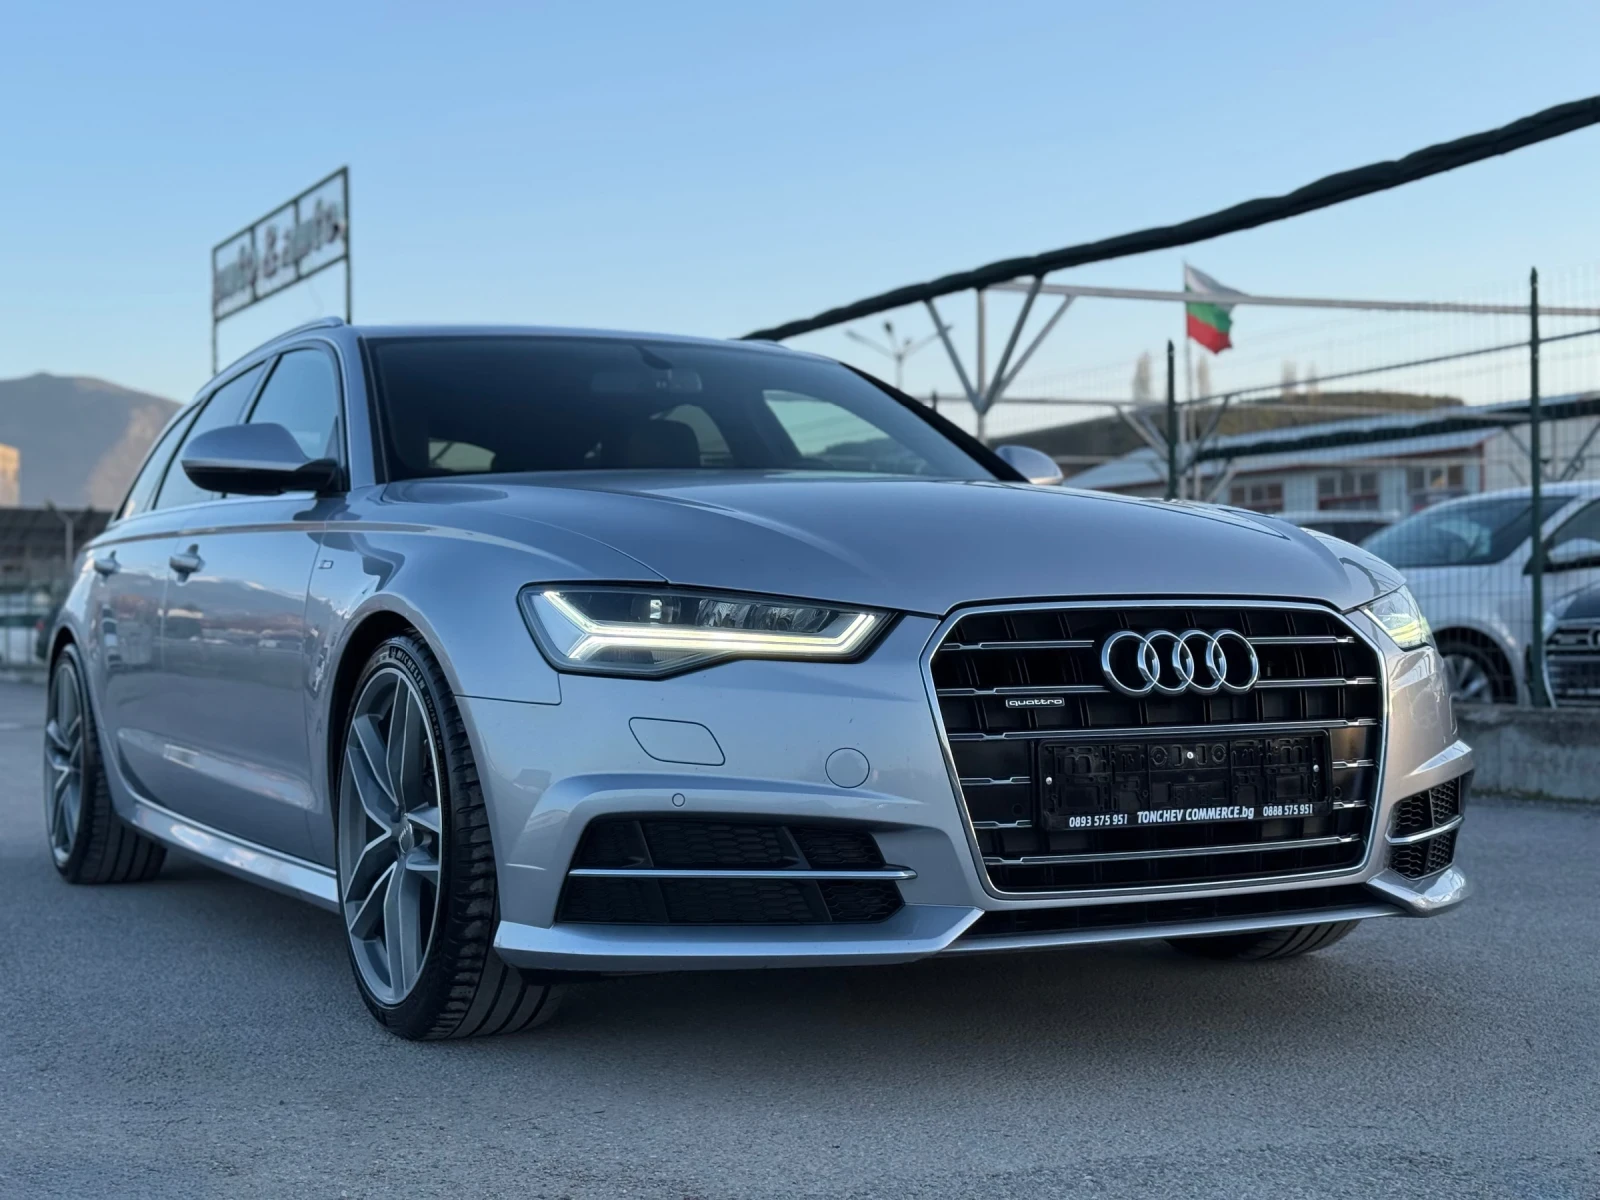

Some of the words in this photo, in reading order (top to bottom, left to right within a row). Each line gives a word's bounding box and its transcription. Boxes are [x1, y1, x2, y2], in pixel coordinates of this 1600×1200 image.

[396, 650, 426, 690] MICHELIN
[1069, 816, 1092, 828] 0893
[1093, 814, 1111, 826] 575
[1112, 813, 1128, 825] 951
[1137, 809, 1184, 824] TONCHEV
[1185, 805, 1255, 821] COMMERCE.bg
[1263, 805, 1283, 817] 0888
[1284, 804, 1299, 816] 575
[1299, 803, 1313, 815] 951
